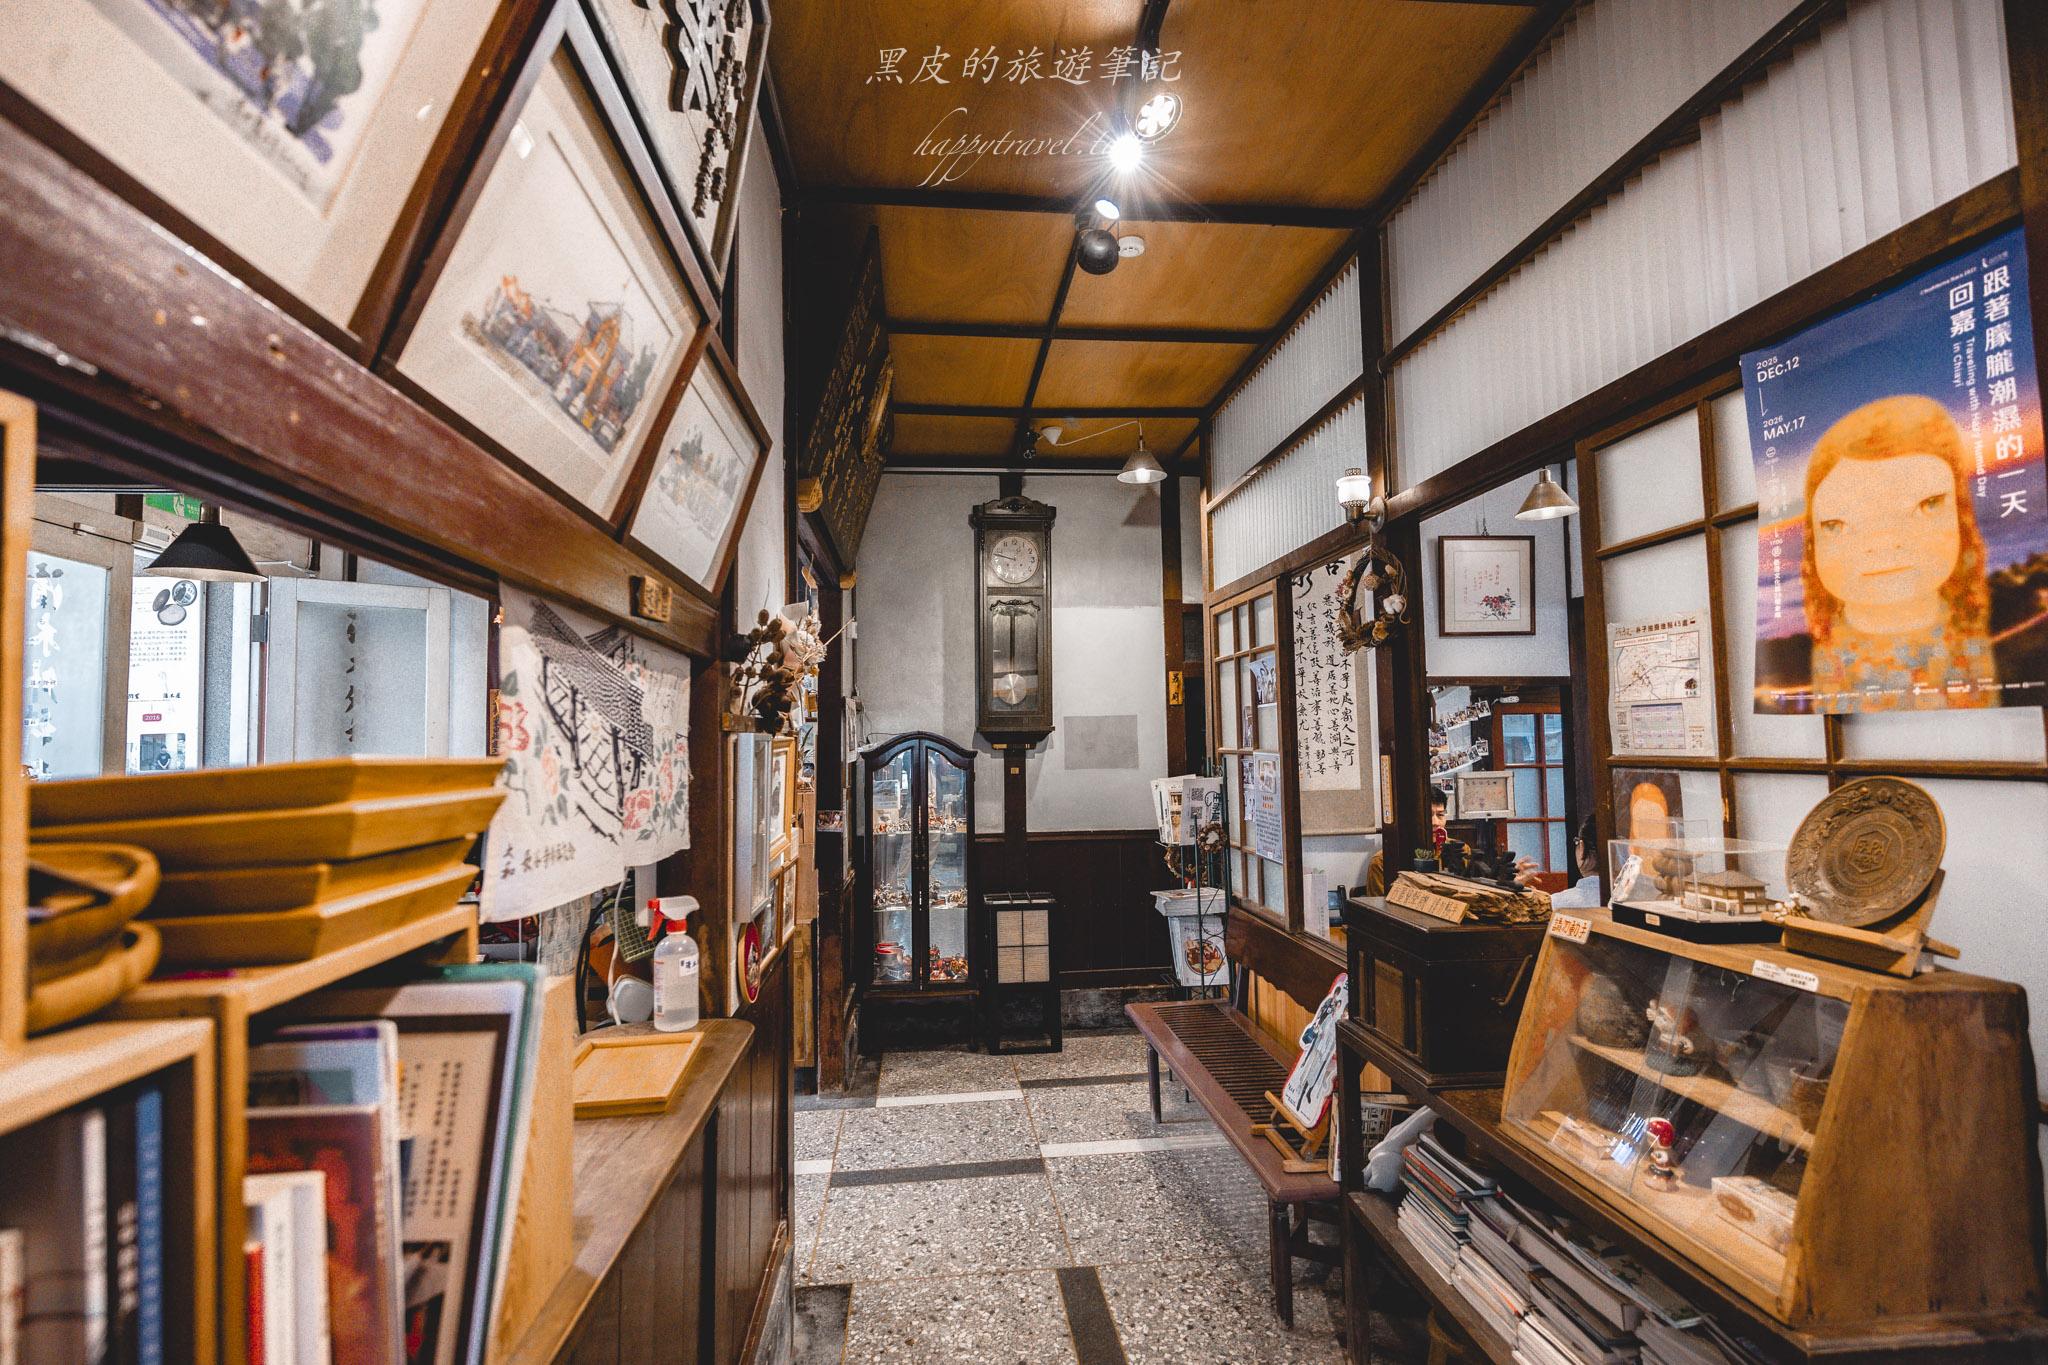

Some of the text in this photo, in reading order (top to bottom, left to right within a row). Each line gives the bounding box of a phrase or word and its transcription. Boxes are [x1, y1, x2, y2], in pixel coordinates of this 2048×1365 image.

[1949, 281, 1977, 338] 回嘉
[1757, 356, 1800, 382] DEC.12
[1953, 354, 1964, 388] Chiayi
[1763, 416, 1806, 440] MAY.17
[1976, 476, 1988, 498] Day
[1551, 917, 1588, 938] 請勿動手
